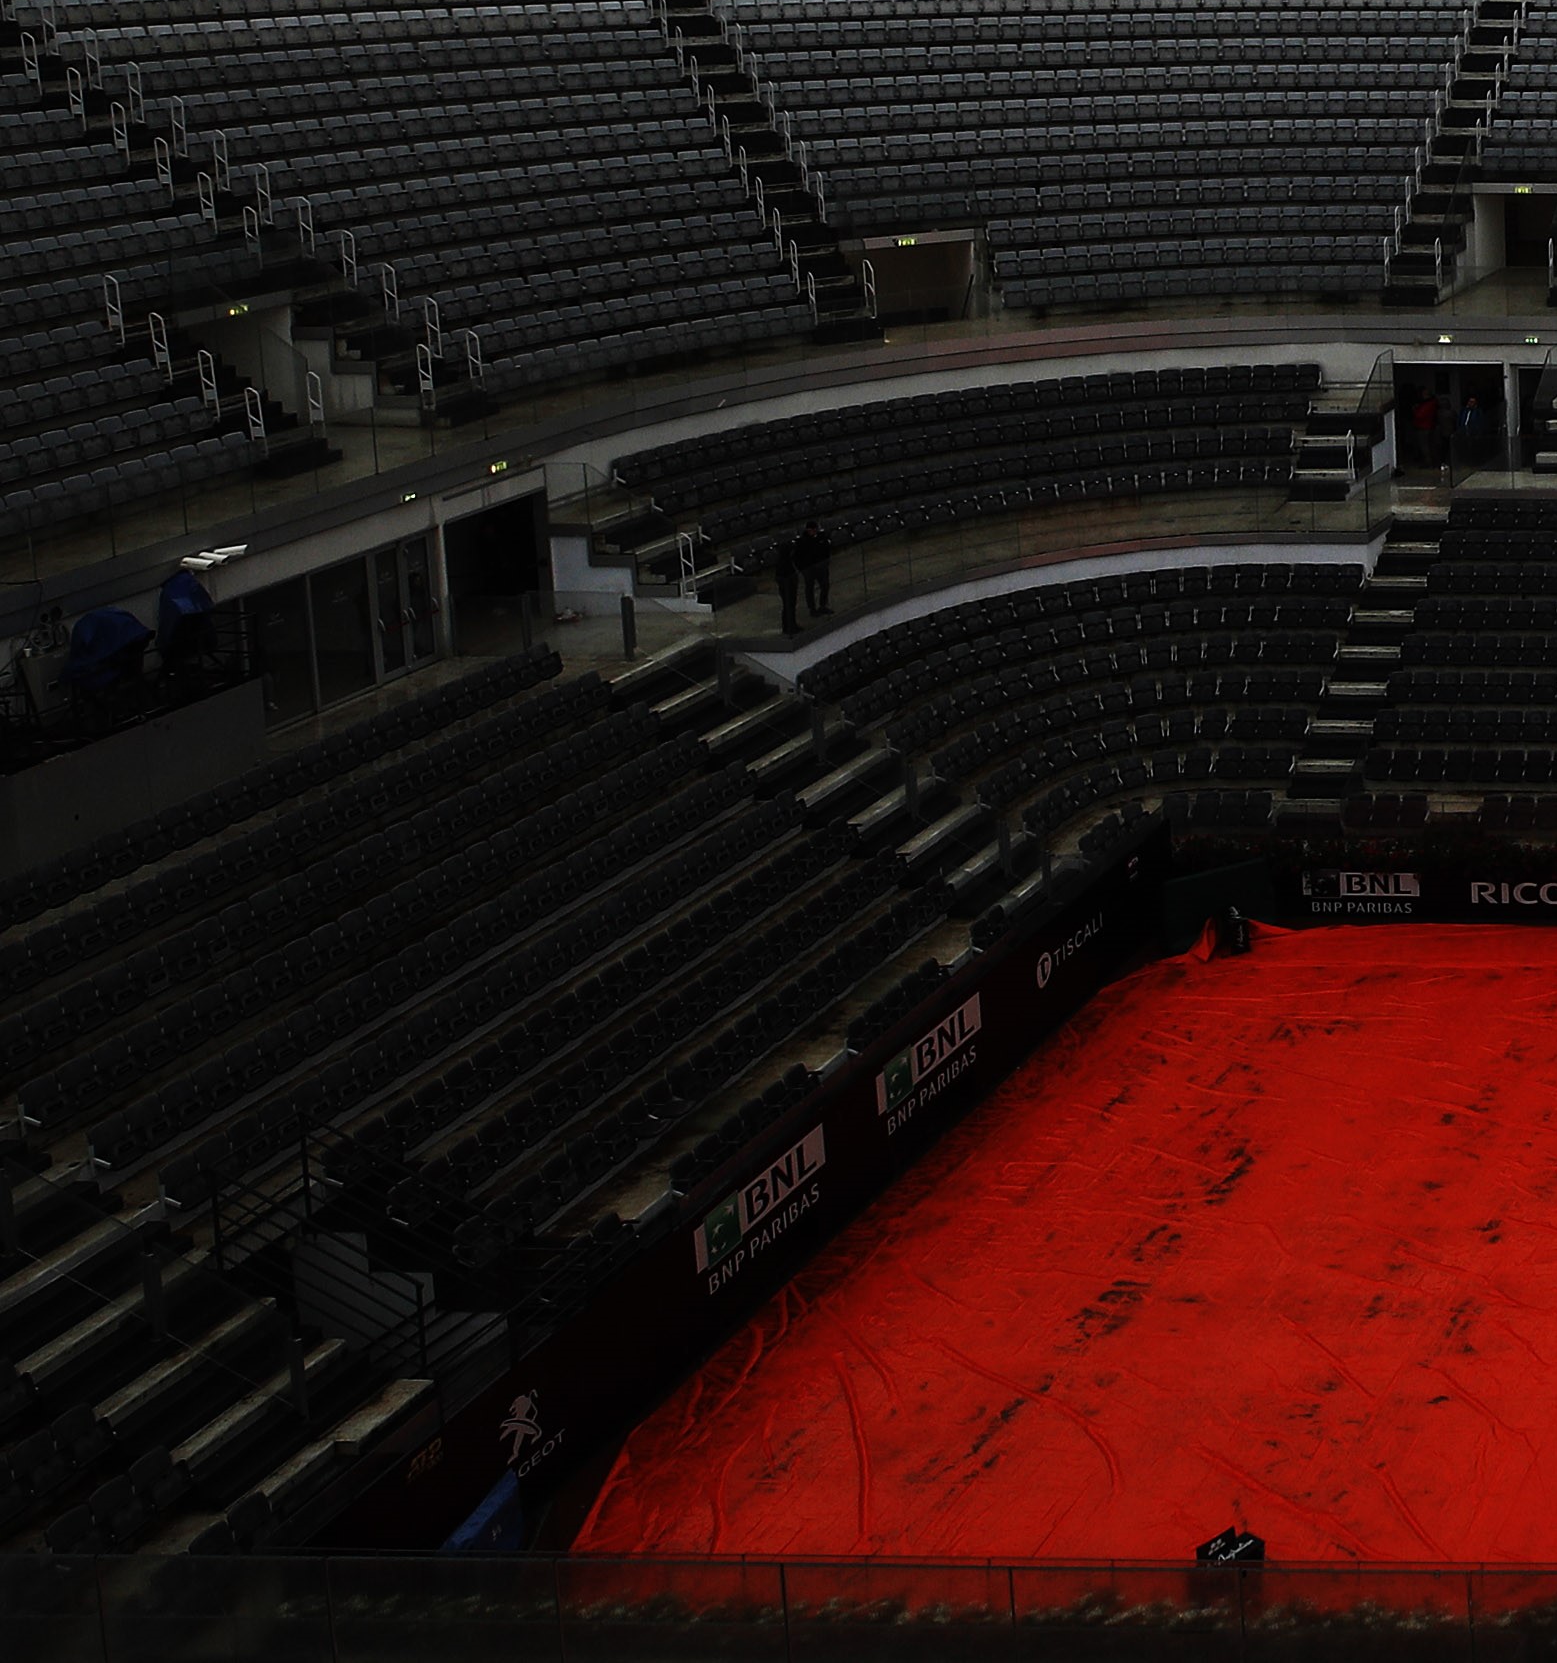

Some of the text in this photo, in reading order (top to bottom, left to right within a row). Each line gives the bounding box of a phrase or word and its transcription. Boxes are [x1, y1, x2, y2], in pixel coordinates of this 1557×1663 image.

[1311, 901, 1413, 914] BNP PARIBAS
[1345, 873, 1412, 894] BNL
[1053, 910, 1104, 967] TISCALI
[917, 1009, 976, 1076] BNL
[887, 1045, 977, 1136] BNP PARIBAS
[744, 1144, 817, 1224] BNL
[708, 1182, 820, 1296] BNP PARIBAS
[517, 1428, 567, 1478] GEOT
